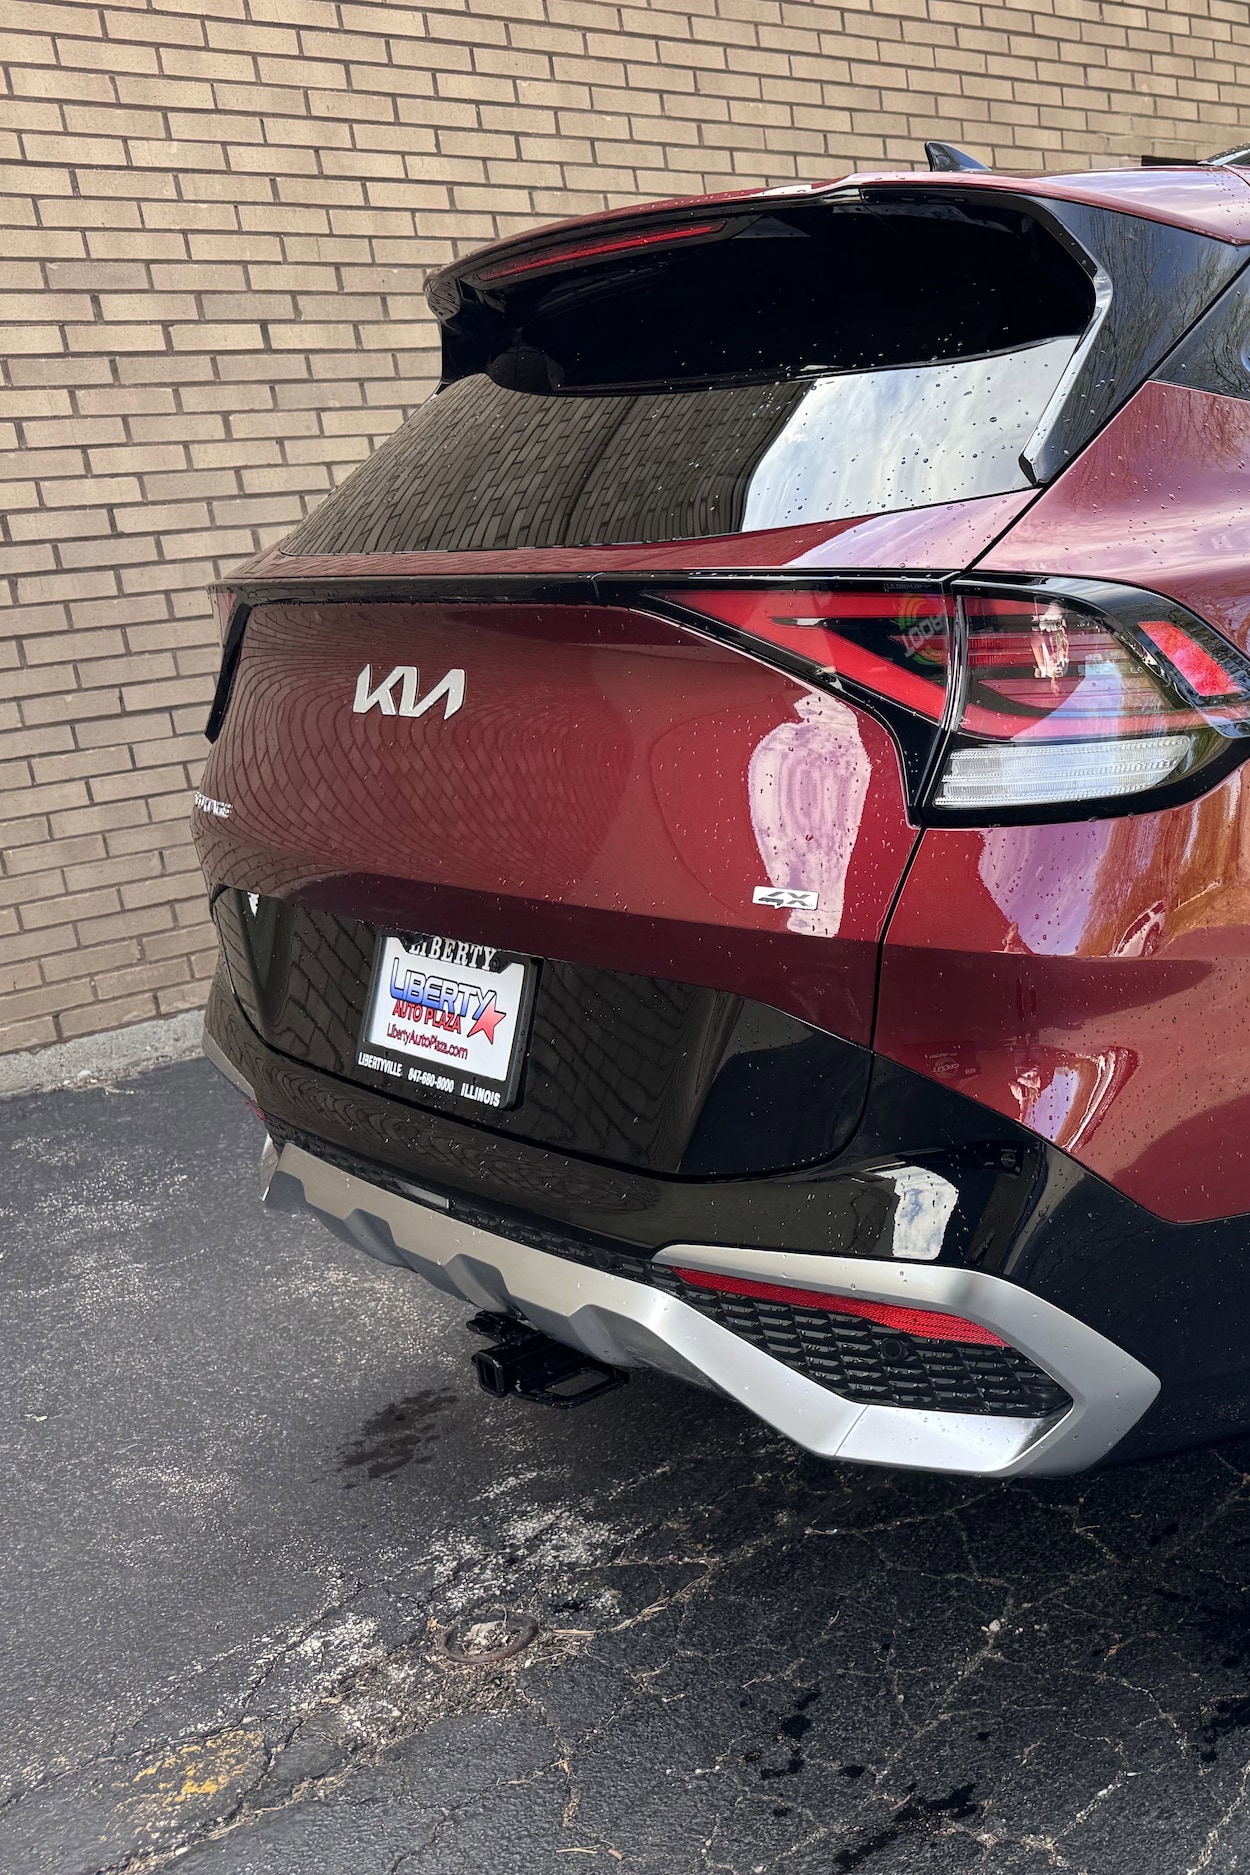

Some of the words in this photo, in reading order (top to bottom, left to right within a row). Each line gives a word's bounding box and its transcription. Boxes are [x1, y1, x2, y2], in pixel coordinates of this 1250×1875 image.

[352, 663, 466, 720] KIA
[408, 936, 497, 971] LIBERTY
[390, 957, 497, 1021] LIBERTY
[392, 1000, 424, 1023] AUTO
[424, 1008, 462, 1034] PLAZA
[386, 1022, 469, 1060] LibertyAutoPlaza.com
[358, 1052, 403, 1077] LIBERTYVILLE
[408, 1067, 455, 1093] 847-680-8000
[460, 1083, 501, 1107] ILLINOIS
